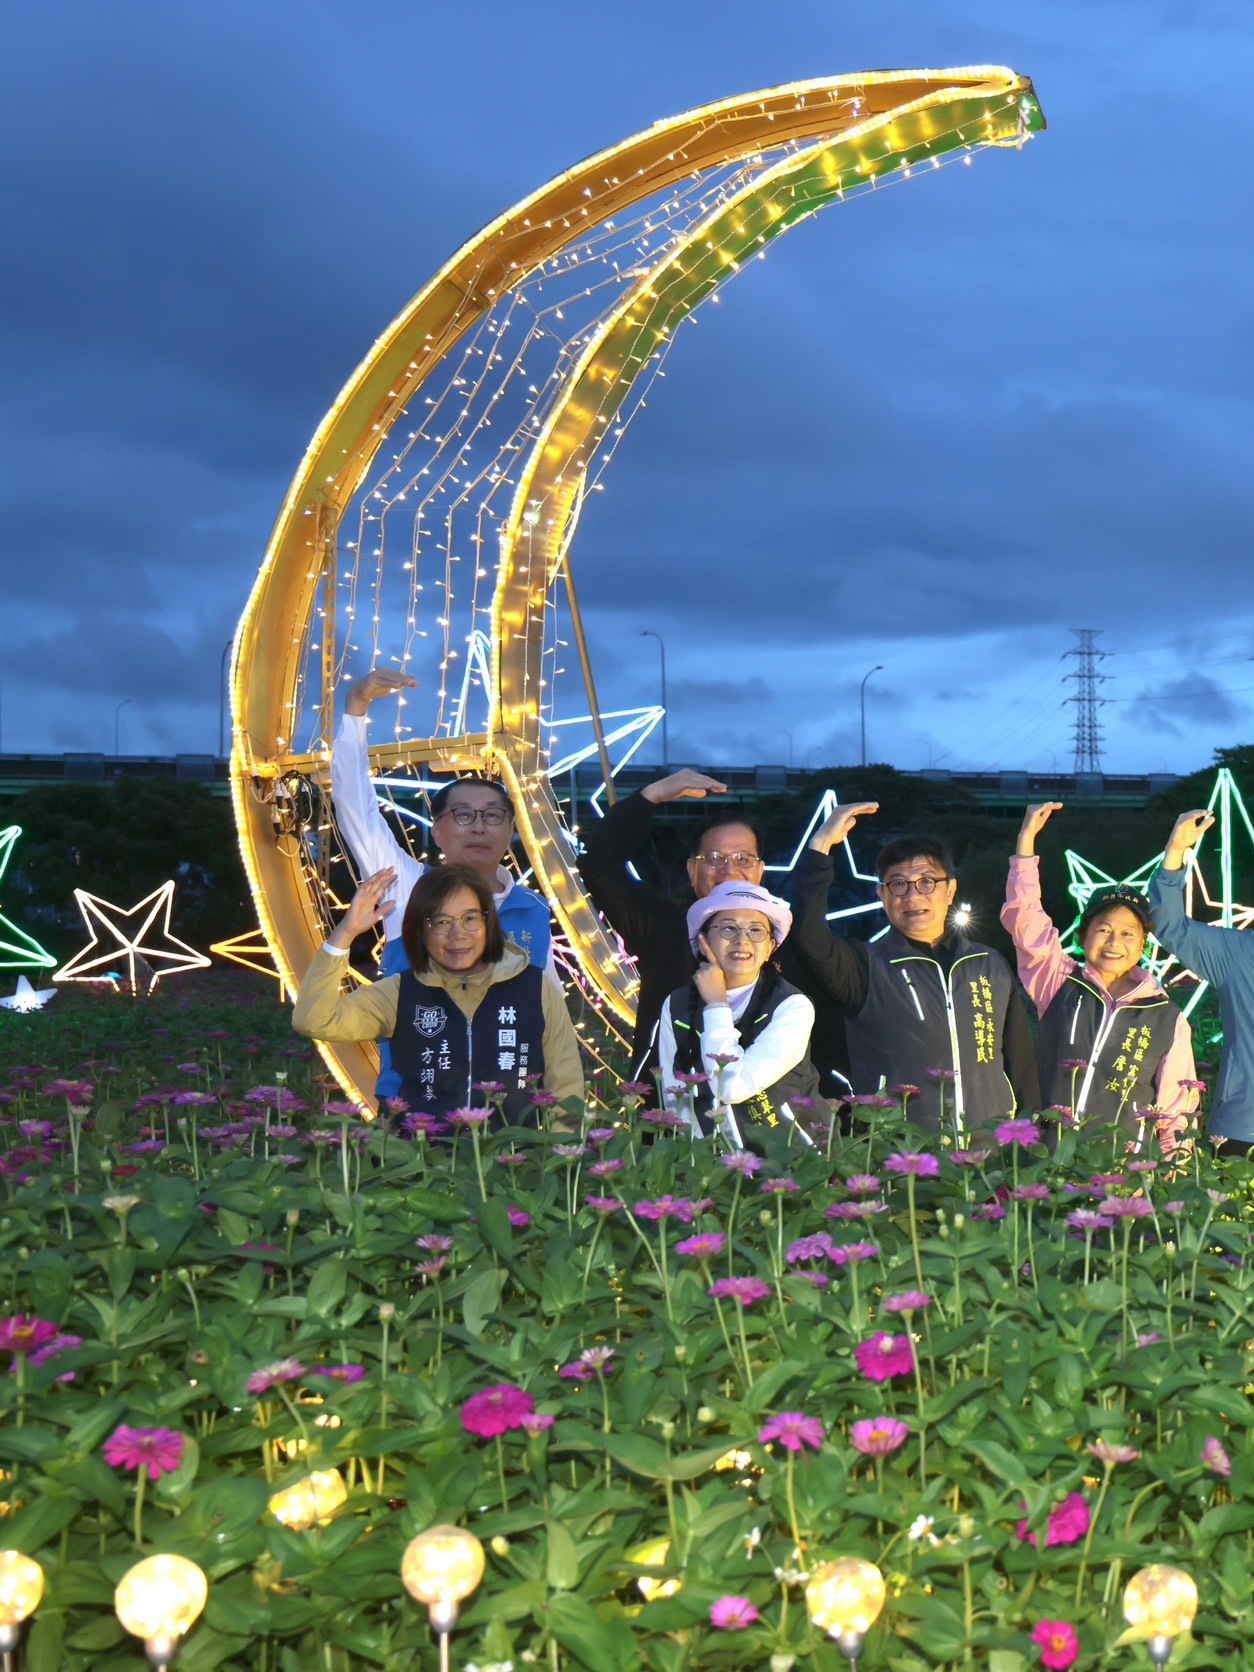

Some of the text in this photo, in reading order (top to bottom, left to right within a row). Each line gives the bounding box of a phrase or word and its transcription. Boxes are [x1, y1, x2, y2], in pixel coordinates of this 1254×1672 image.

[969, 981, 983, 1007] 里長
[979, 975, 994, 1013] 板橋區
[438, 1039, 451, 1070] 主任
[498, 1006, 517, 1070] 林國春
[1122, 1027, 1137, 1052] 里長
[1133, 1025, 1151, 1061] 板橋區
[518, 1043, 529, 1089] 服務團隊
